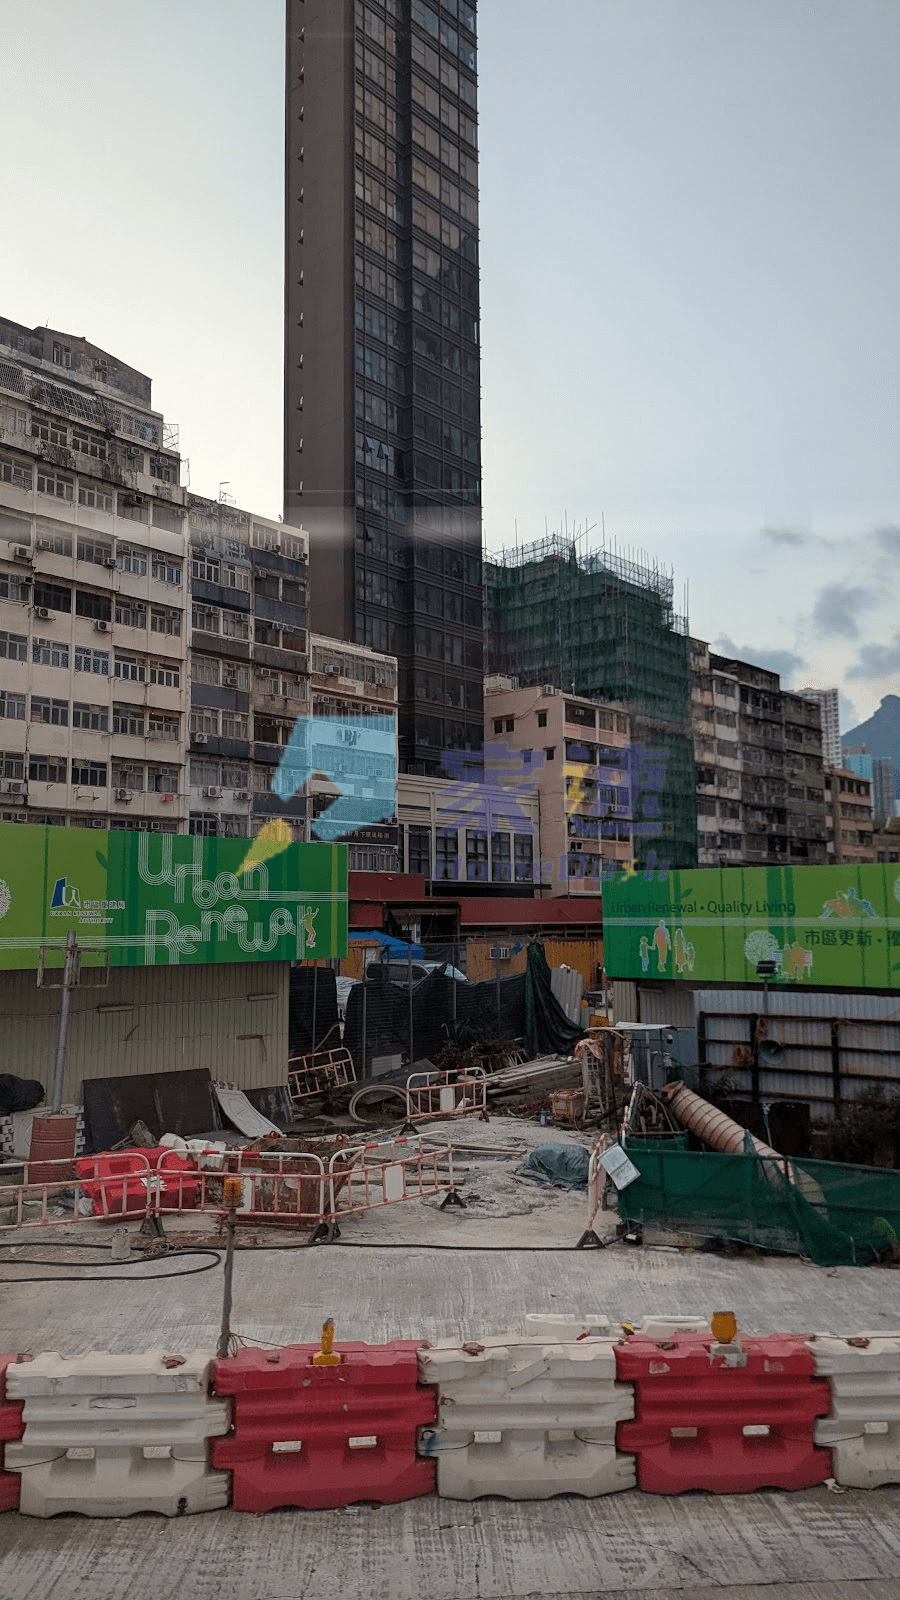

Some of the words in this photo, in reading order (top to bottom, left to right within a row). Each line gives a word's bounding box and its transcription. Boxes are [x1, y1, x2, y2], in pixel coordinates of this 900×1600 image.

[138, 832, 269, 909] Urban
[144, 904, 306, 966] Renewal
[611, 902, 646, 913] Urban
[649, 901, 697, 913] Renewal
[707, 900, 753, 915] Quality
[756, 900, 796, 916] Living
